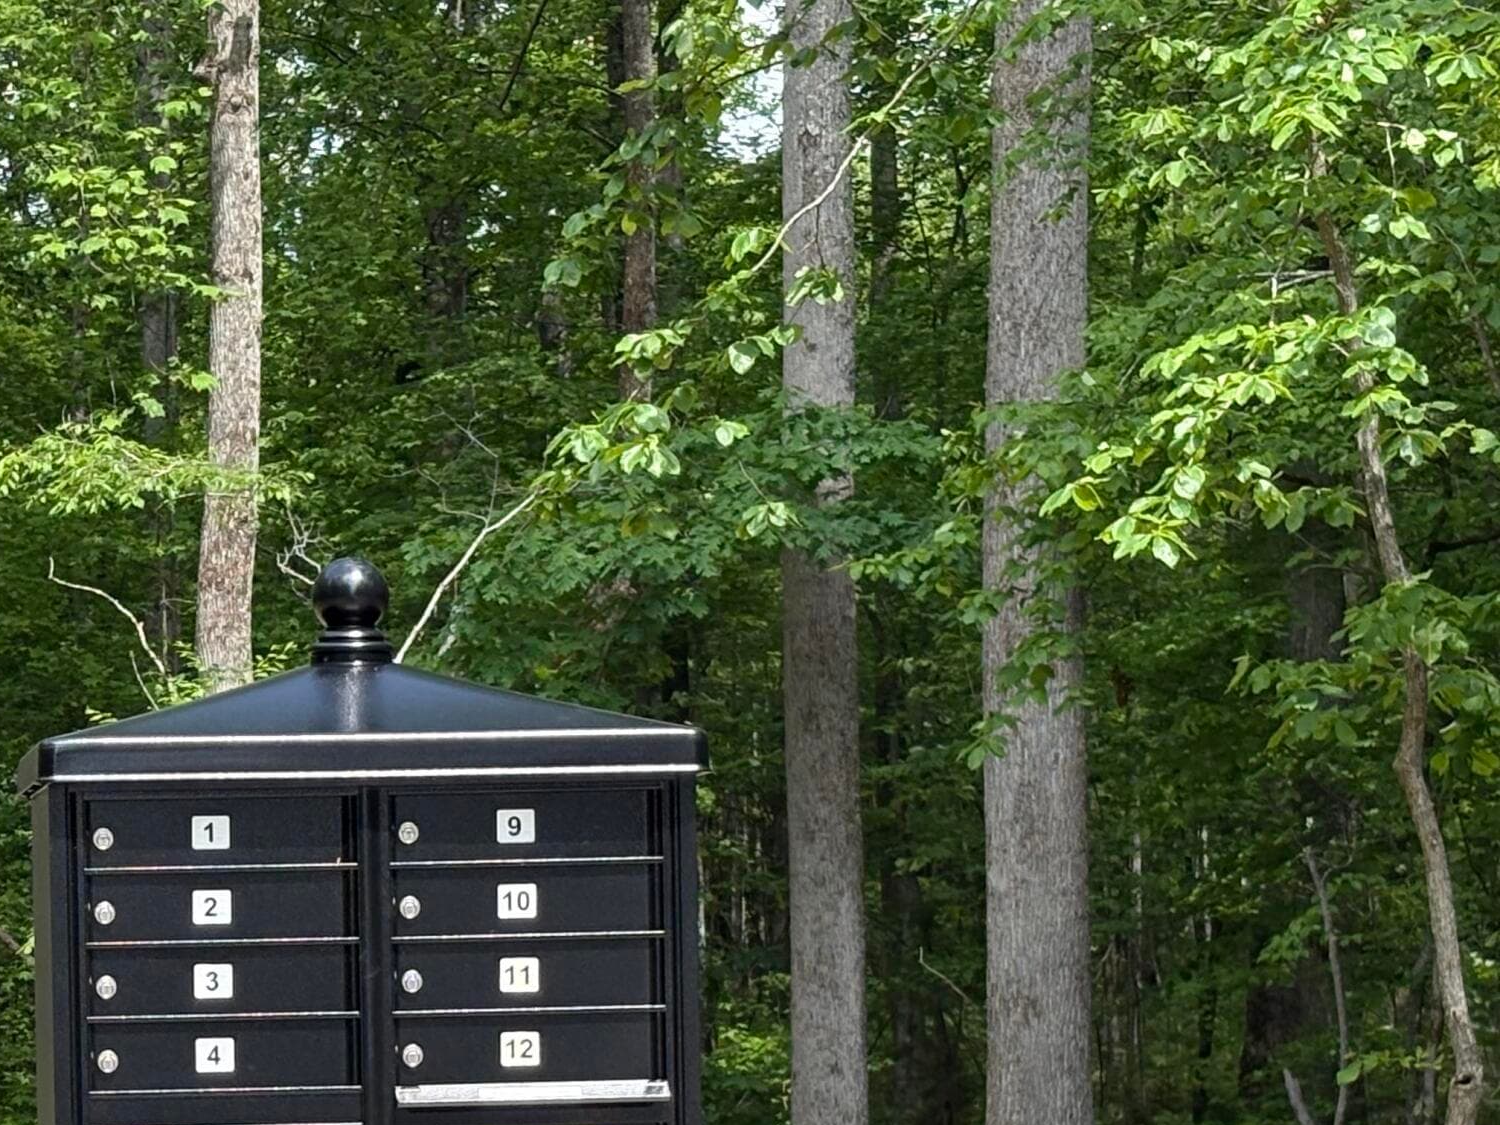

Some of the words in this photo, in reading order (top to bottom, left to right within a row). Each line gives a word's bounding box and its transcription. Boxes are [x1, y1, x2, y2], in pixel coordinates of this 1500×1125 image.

[203, 822, 214, 842] 1
[508, 816, 521, 836] 9
[204, 897, 217, 917] 2
[503, 891, 530, 911] 10
[206, 972, 219, 991] 3
[505, 965, 529, 985] 11
[207, 1045, 221, 1065] 4
[506, 1038, 533, 1058] 12
